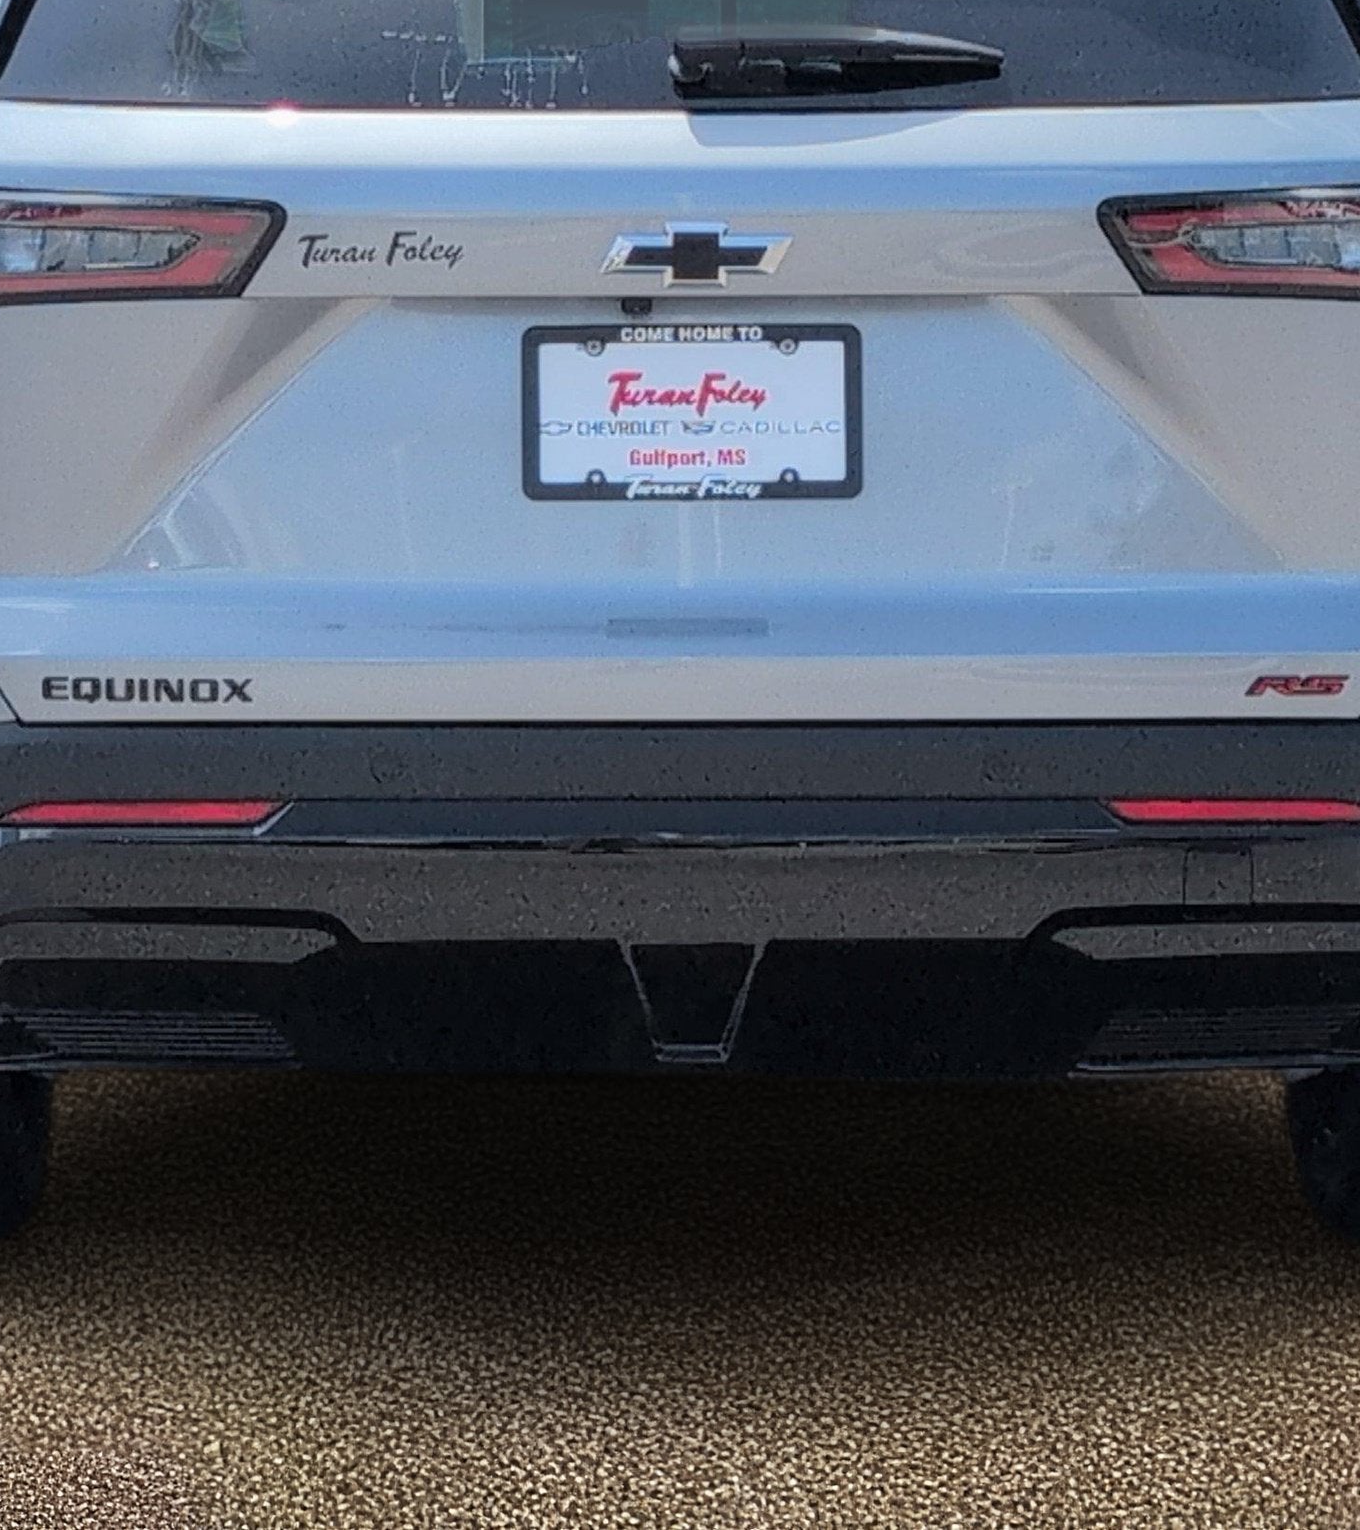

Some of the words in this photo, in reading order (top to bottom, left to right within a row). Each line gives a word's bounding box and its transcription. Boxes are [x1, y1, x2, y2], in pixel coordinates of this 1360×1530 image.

[298, 234, 377, 269] Turan
[386, 231, 464, 269] Foley
[620, 326, 674, 342] COME
[678, 325, 734, 342] HOME
[736, 326, 763, 341] TO
[607, 371, 696, 417] Turan
[695, 372, 766, 417] Foley
[576, 421, 669, 436] CHEVROLET
[720, 421, 840, 435] CADILLAC
[629, 449, 712, 469] Gulfport,
[717, 449, 746, 466] MS
[42, 676, 253, 703] EQUINOX
[1245, 675, 1350, 696] RS
